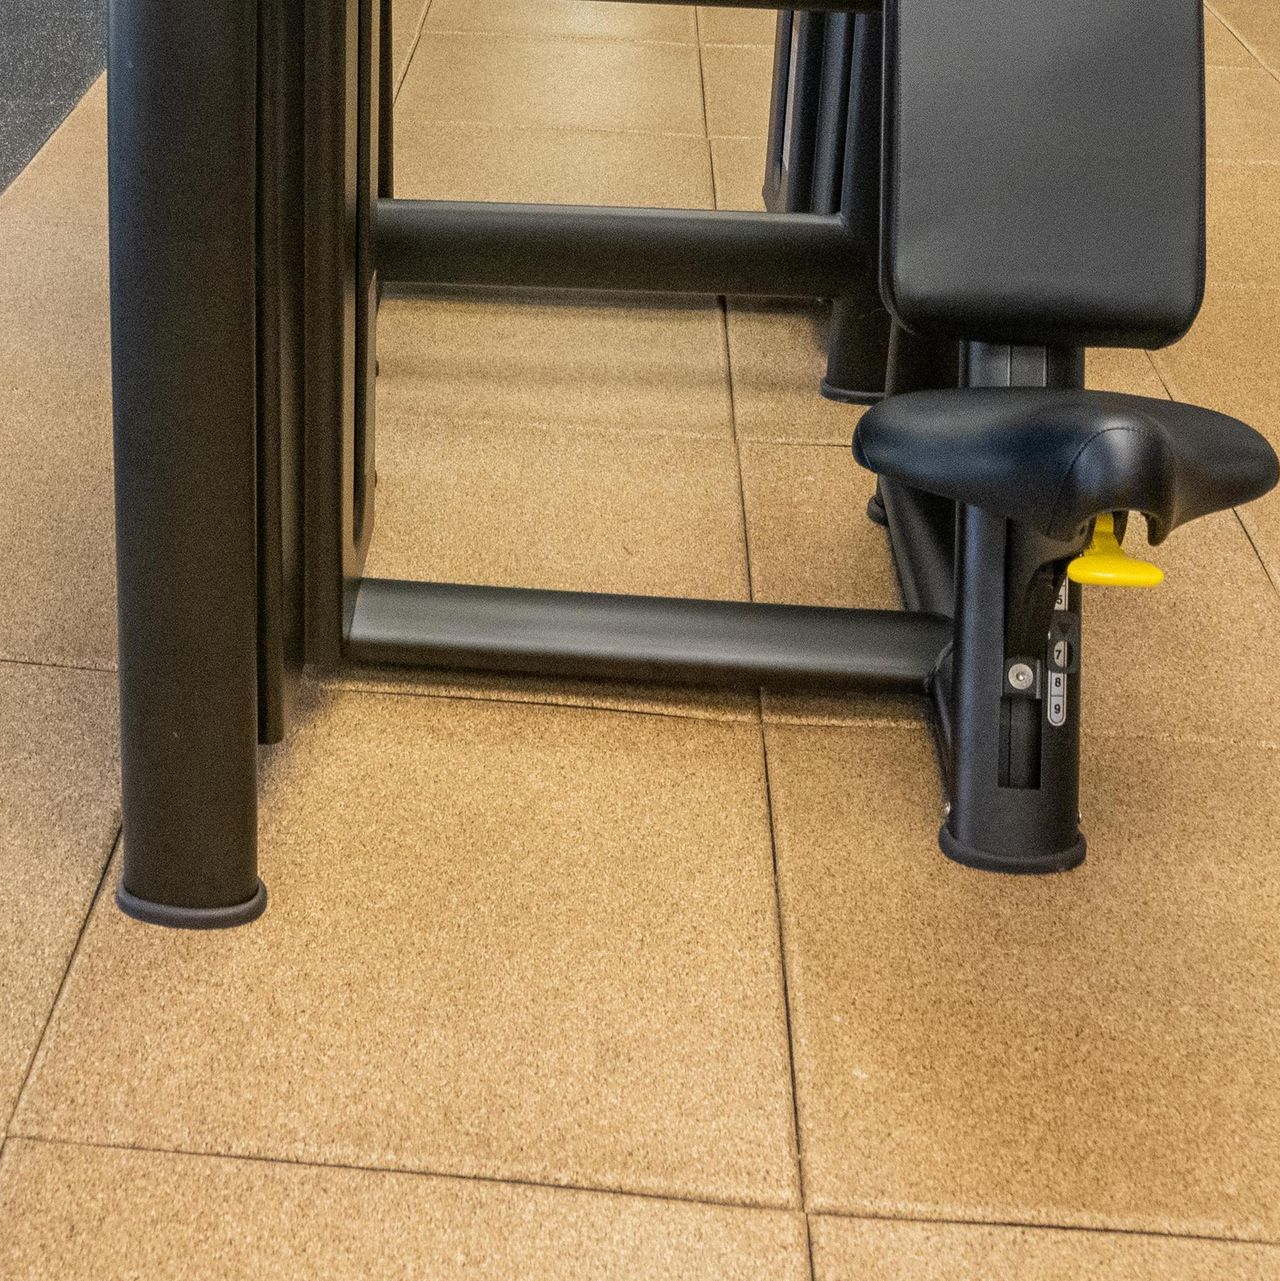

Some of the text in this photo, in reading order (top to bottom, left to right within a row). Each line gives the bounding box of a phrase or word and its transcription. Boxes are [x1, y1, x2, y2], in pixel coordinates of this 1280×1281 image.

[1055, 649, 1062, 660] 7
[1054, 677, 1062, 688] 8
[1054, 704, 1061, 715] 9
